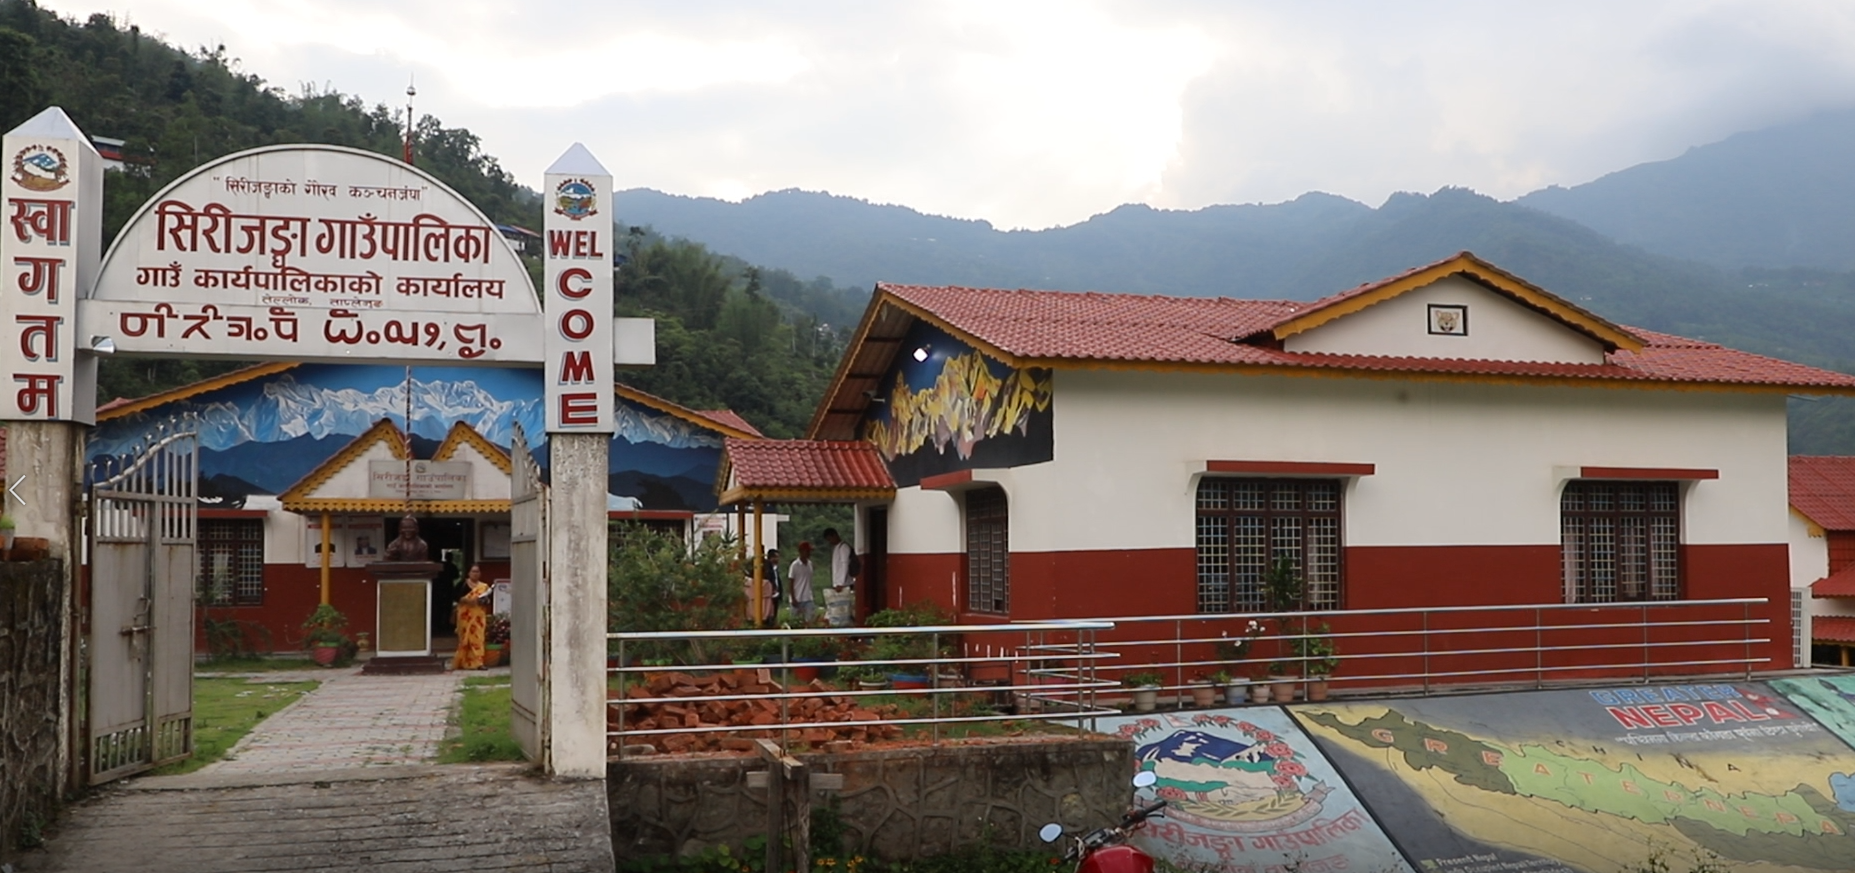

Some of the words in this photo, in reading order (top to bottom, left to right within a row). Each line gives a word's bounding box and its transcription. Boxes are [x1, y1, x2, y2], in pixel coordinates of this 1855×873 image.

[315, 213, 492, 264] गाउँपालिका
[136, 261, 182, 288] गाउँ
[194, 265, 384, 295] कार्यपालिकाको
[396, 273, 506, 299] कार्यालय
[548, 229, 604, 425] WELCOME
[1588, 684, 1743, 705] GREATER
[1605, 700, 1772, 730] NEPAL
